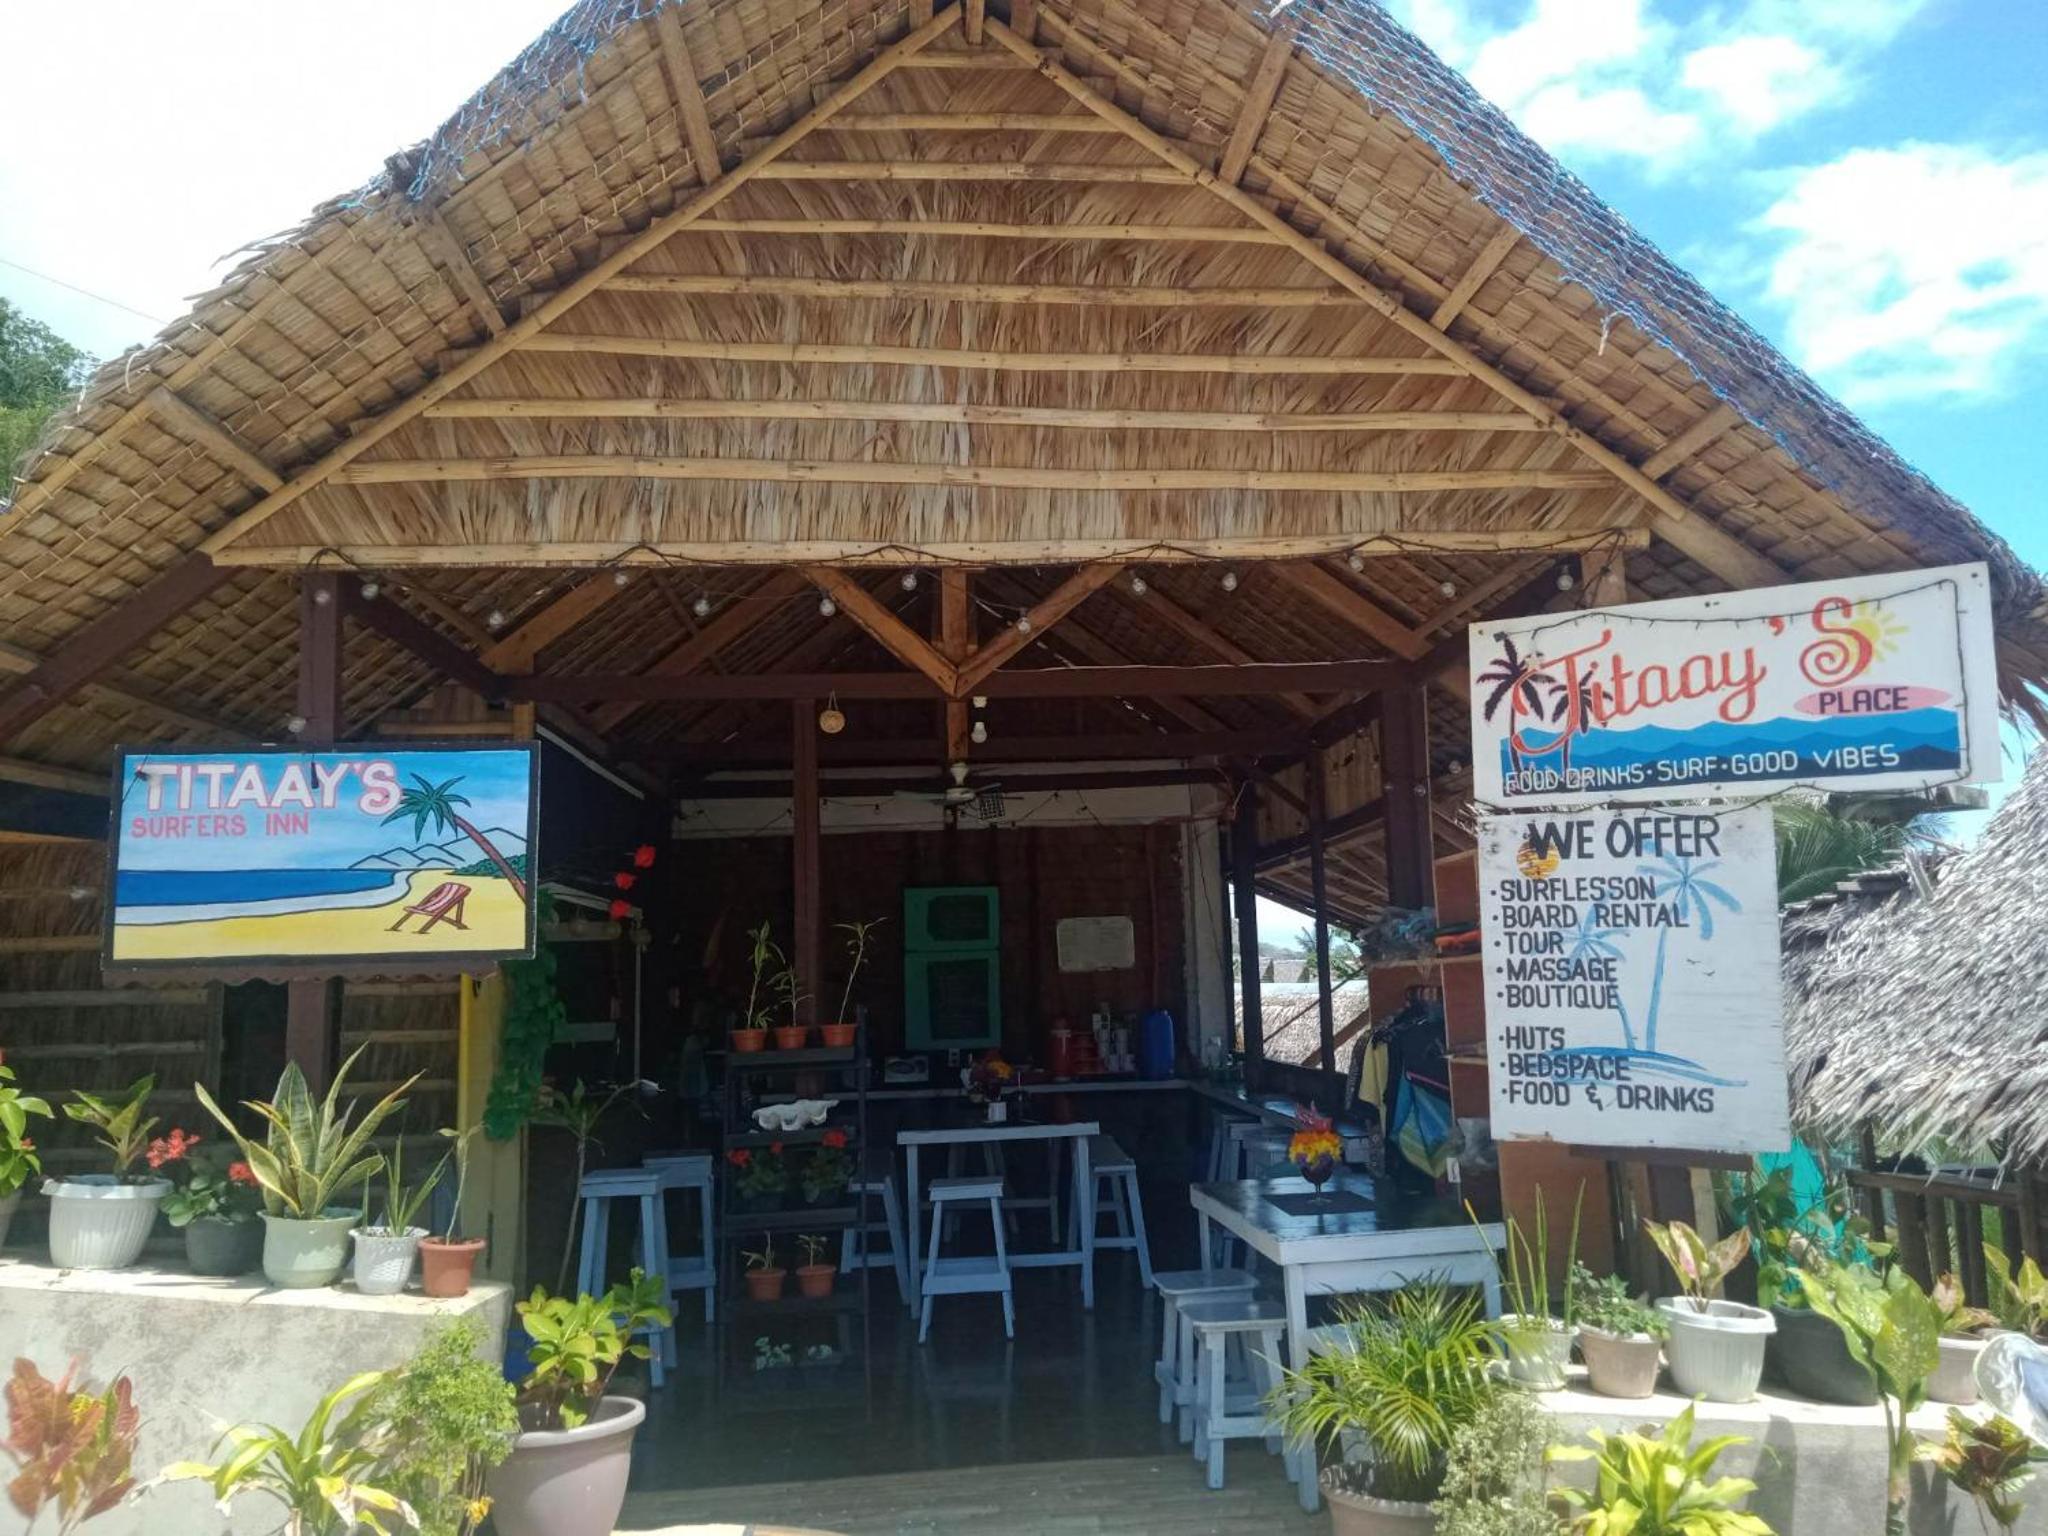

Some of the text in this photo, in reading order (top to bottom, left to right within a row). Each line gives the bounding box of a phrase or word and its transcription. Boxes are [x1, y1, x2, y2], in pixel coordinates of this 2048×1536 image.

[1819, 686, 1909, 714] PLACE
[1504, 769, 1559, 793] FOOD
[1657, 756, 1718, 781] SURF
[1731, 750, 1798, 775] GOOD
[1812, 744, 1900, 769] VIBES
[137, 759, 402, 815] TITAAY'S
[131, 812, 309, 839] SURFERS INN
[1527, 815, 1720, 859] WE OFFER
[1501, 903, 1689, 928] BOARD RENTAL
[1503, 931, 1564, 954] TOUR
[1506, 958, 1618, 982] MASSAGE
[1505, 984, 1619, 1009] BOUTIQUE
[1505, 1026, 1565, 1050] HUTS
[1508, 1053, 1631, 1081] BEDSPACE
[1508, 1080, 1714, 1113] FOOD & DRINKS
